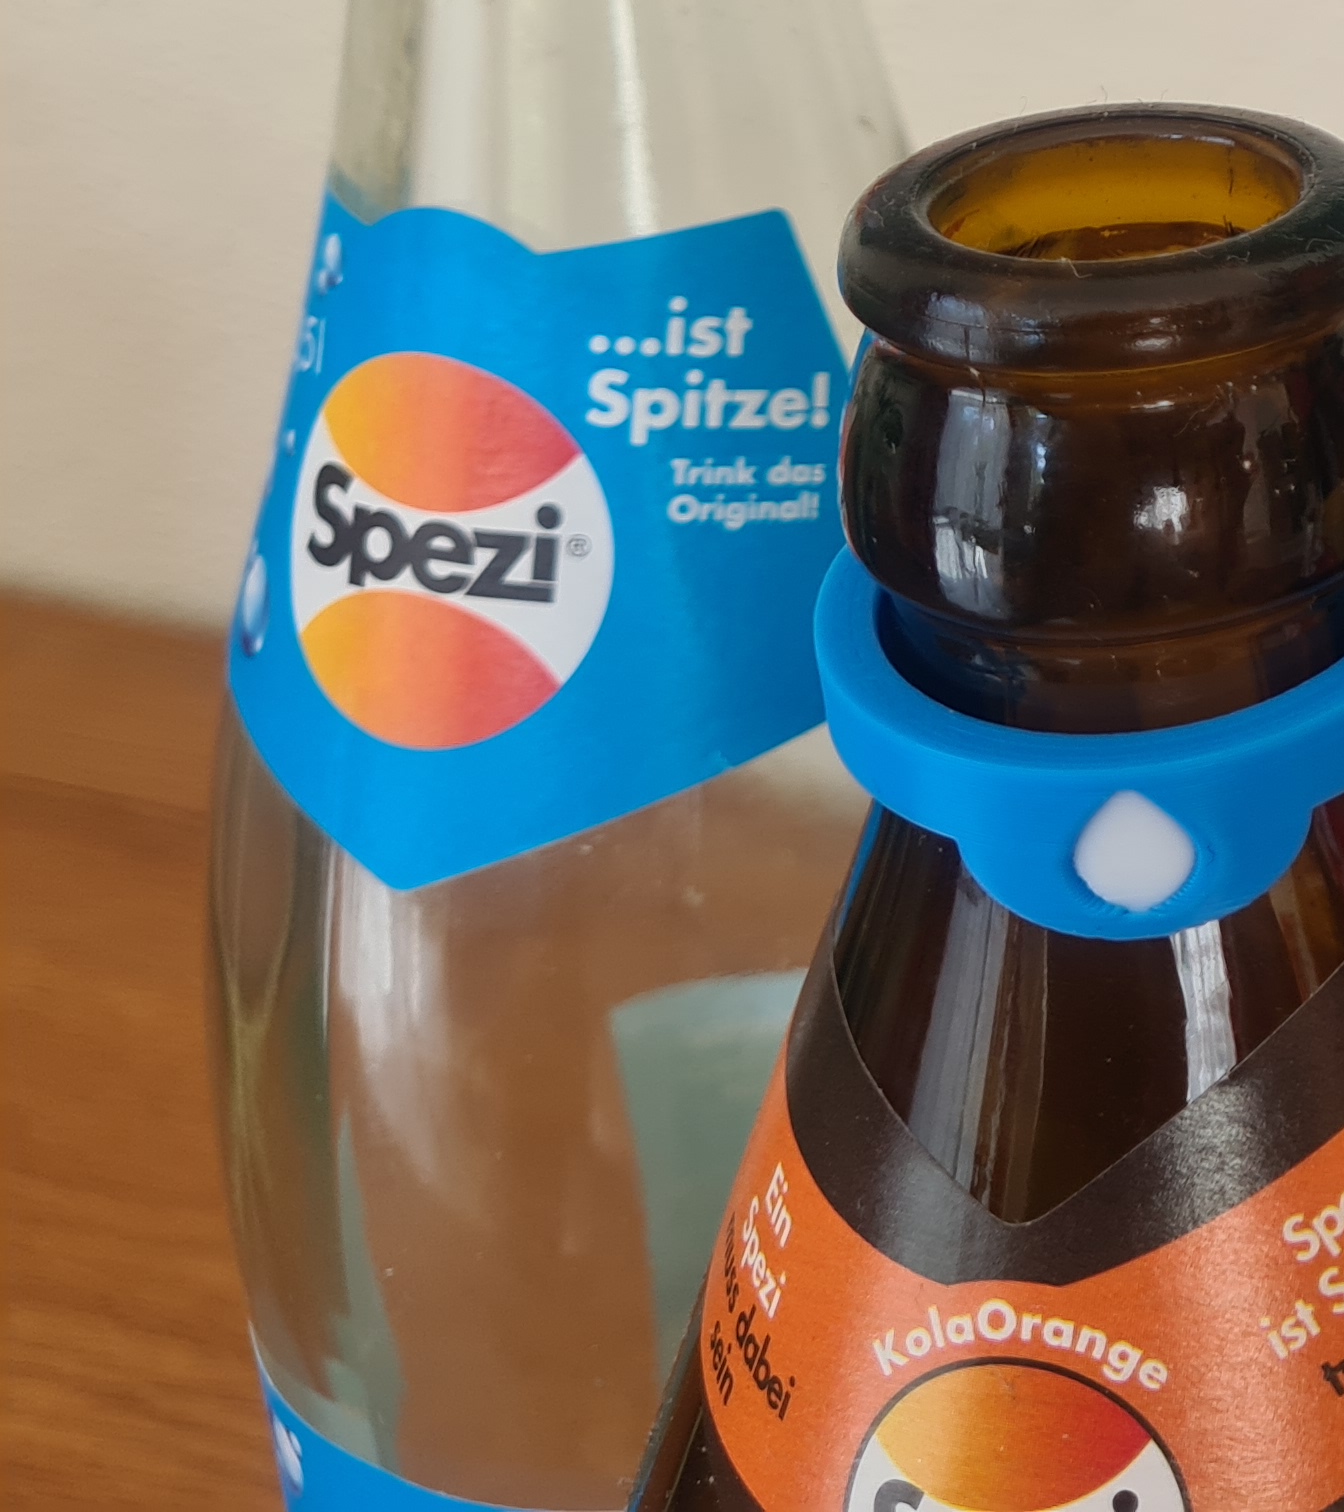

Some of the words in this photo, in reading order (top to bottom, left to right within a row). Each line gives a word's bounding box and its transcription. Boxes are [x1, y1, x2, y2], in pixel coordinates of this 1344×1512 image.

[584, 367, 832, 448] Spitze!
[669, 455, 757, 487] Trink
[765, 454, 827, 486] das
[765, 1161, 793, 1250] Ein
[741, 1194, 787, 1320] Spezi
[709, 1319, 735, 1407] sein
[735, 1302, 797, 1422] dabei
[871, 1297, 1170, 1391] KolaOrange
[1258, 1297, 1322, 1361] ist
